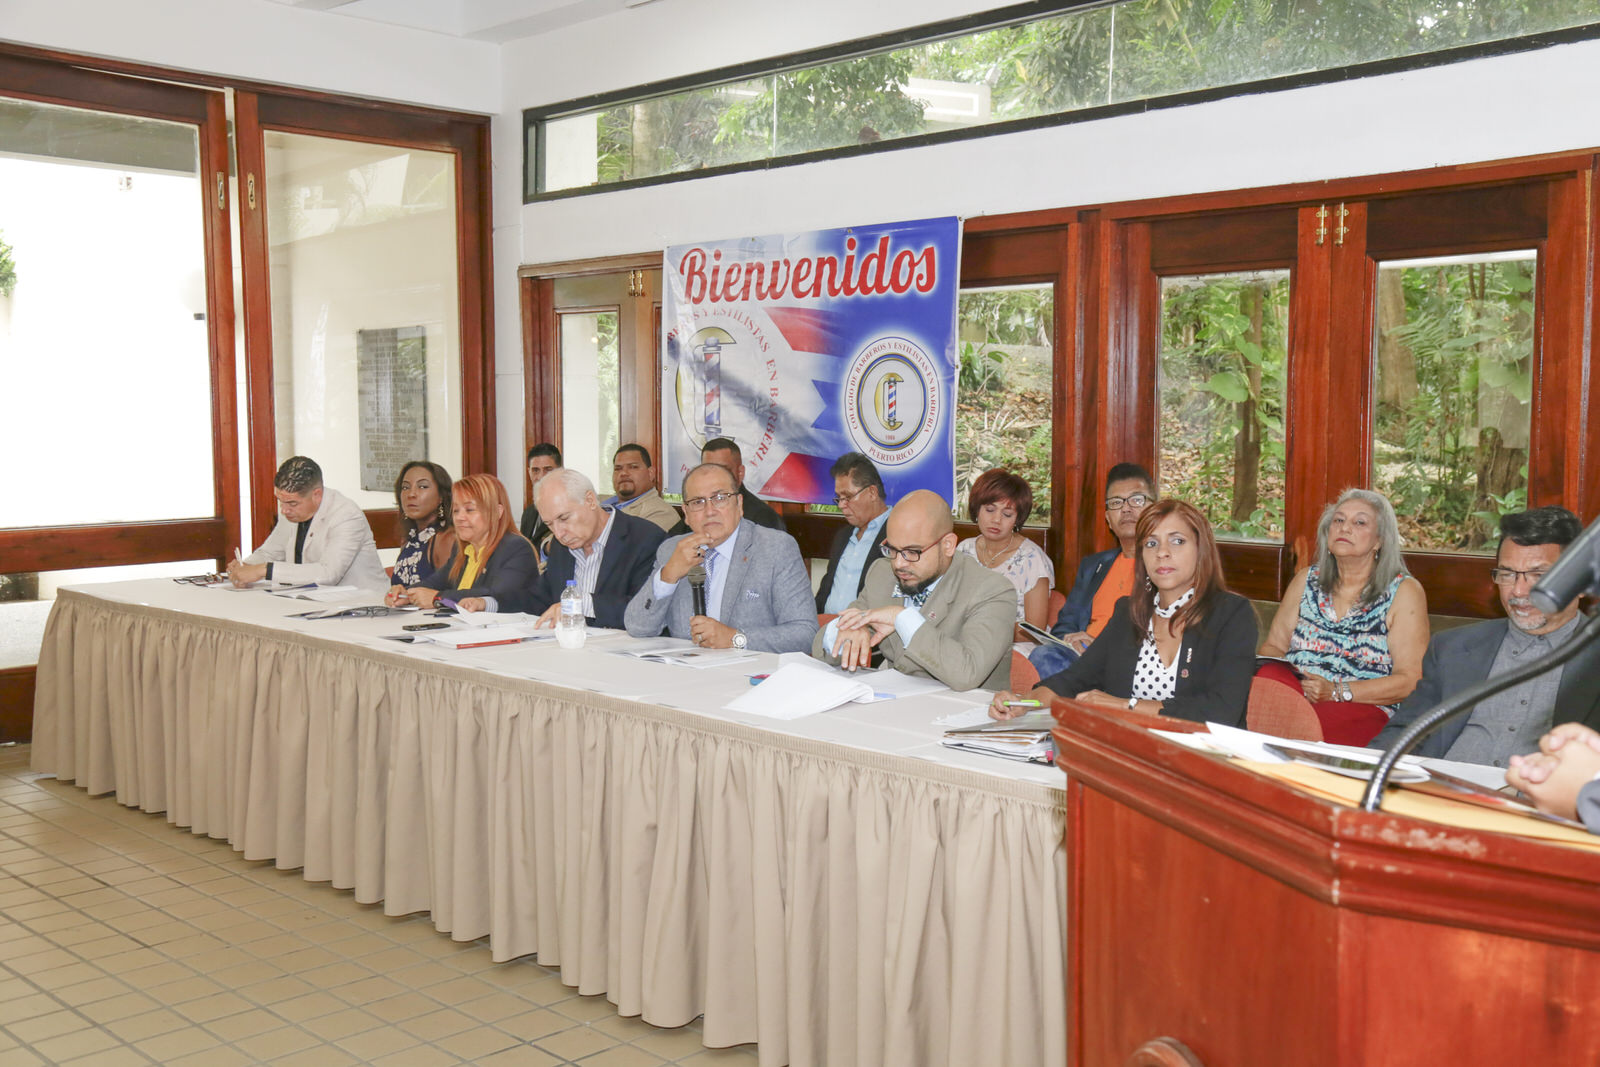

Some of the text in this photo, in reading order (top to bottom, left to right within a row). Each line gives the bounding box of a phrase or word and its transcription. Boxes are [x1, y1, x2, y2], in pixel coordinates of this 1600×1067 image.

[679, 236, 936, 305] Bienvenidos
[855, 343, 886, 374] BARBEROS
[894, 341, 929, 371] ESTILISTAS
[766, 359, 778, 381] EN
[852, 375, 858, 387] DE
[926, 371, 934, 384] EN
[848, 387, 858, 430] COLEGIO
[868, 446, 914, 462] PUERTO RICO
